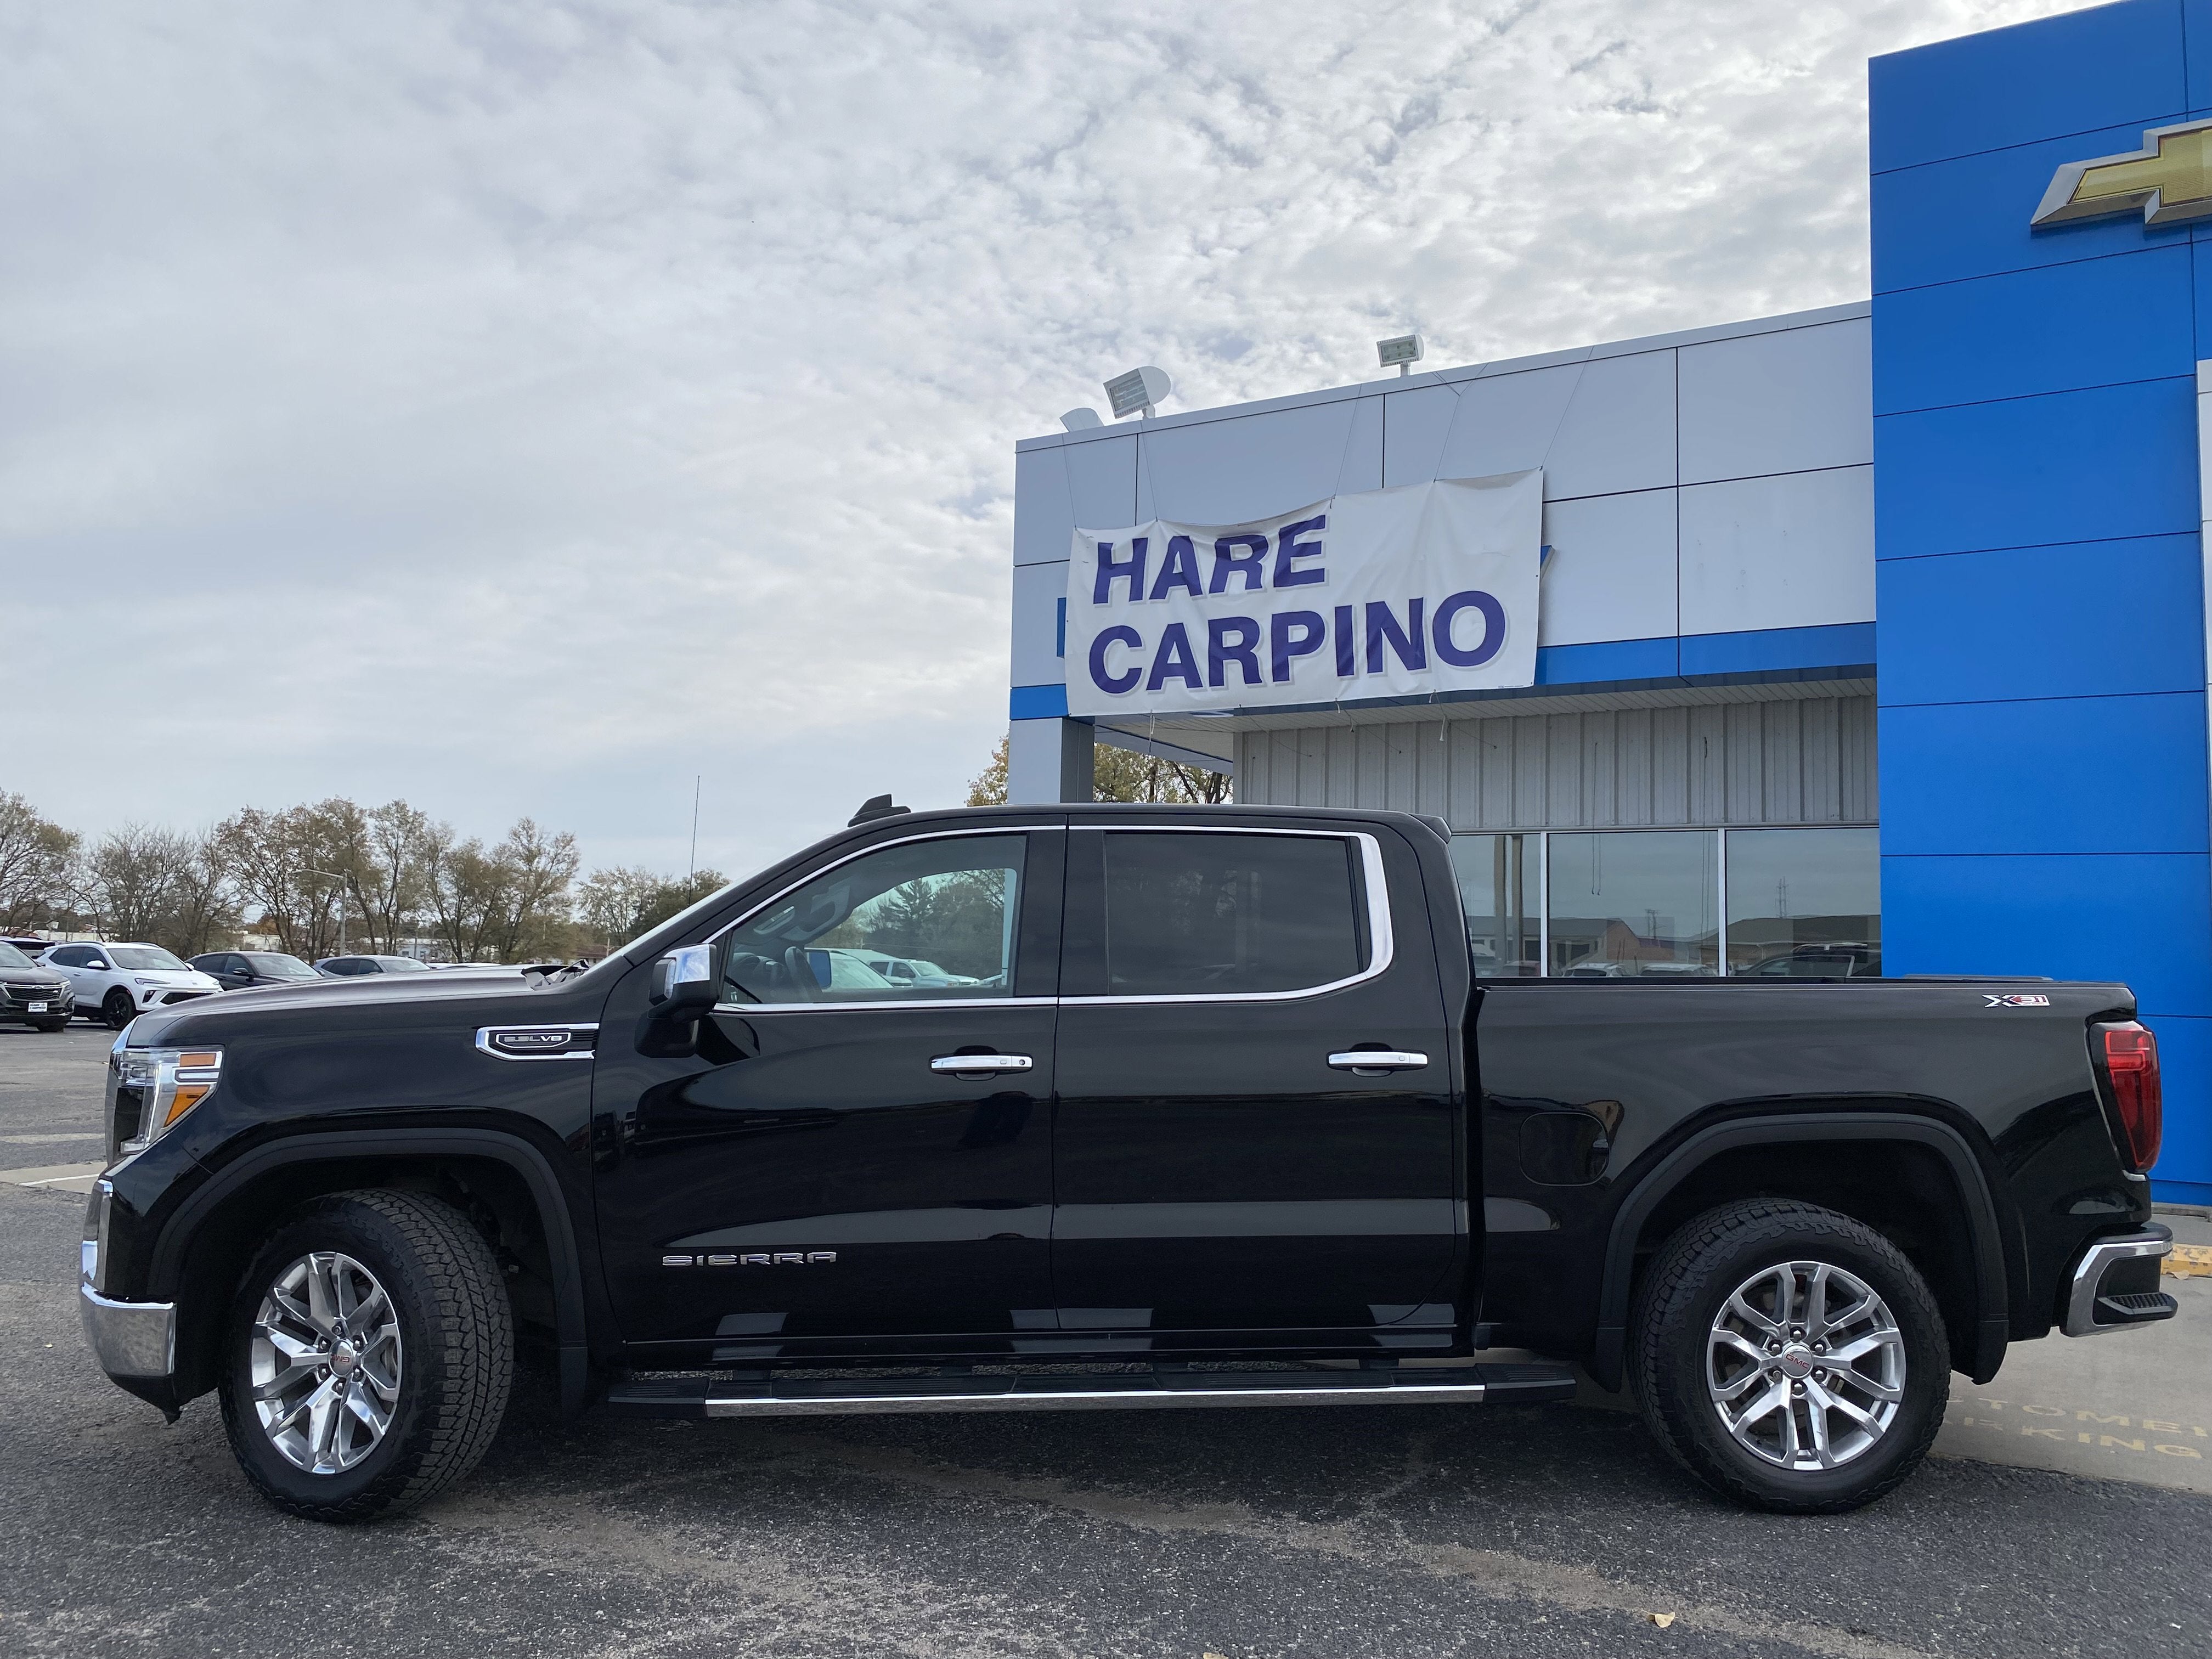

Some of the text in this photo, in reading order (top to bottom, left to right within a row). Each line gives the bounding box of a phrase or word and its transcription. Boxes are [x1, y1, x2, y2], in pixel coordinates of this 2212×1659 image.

[1093, 515, 1327, 605] HARE
[1088, 590, 1506, 695] CARPINO
[662, 1251, 837, 1266] SIERRA
[1786, 1353, 1810, 1369] GMC
